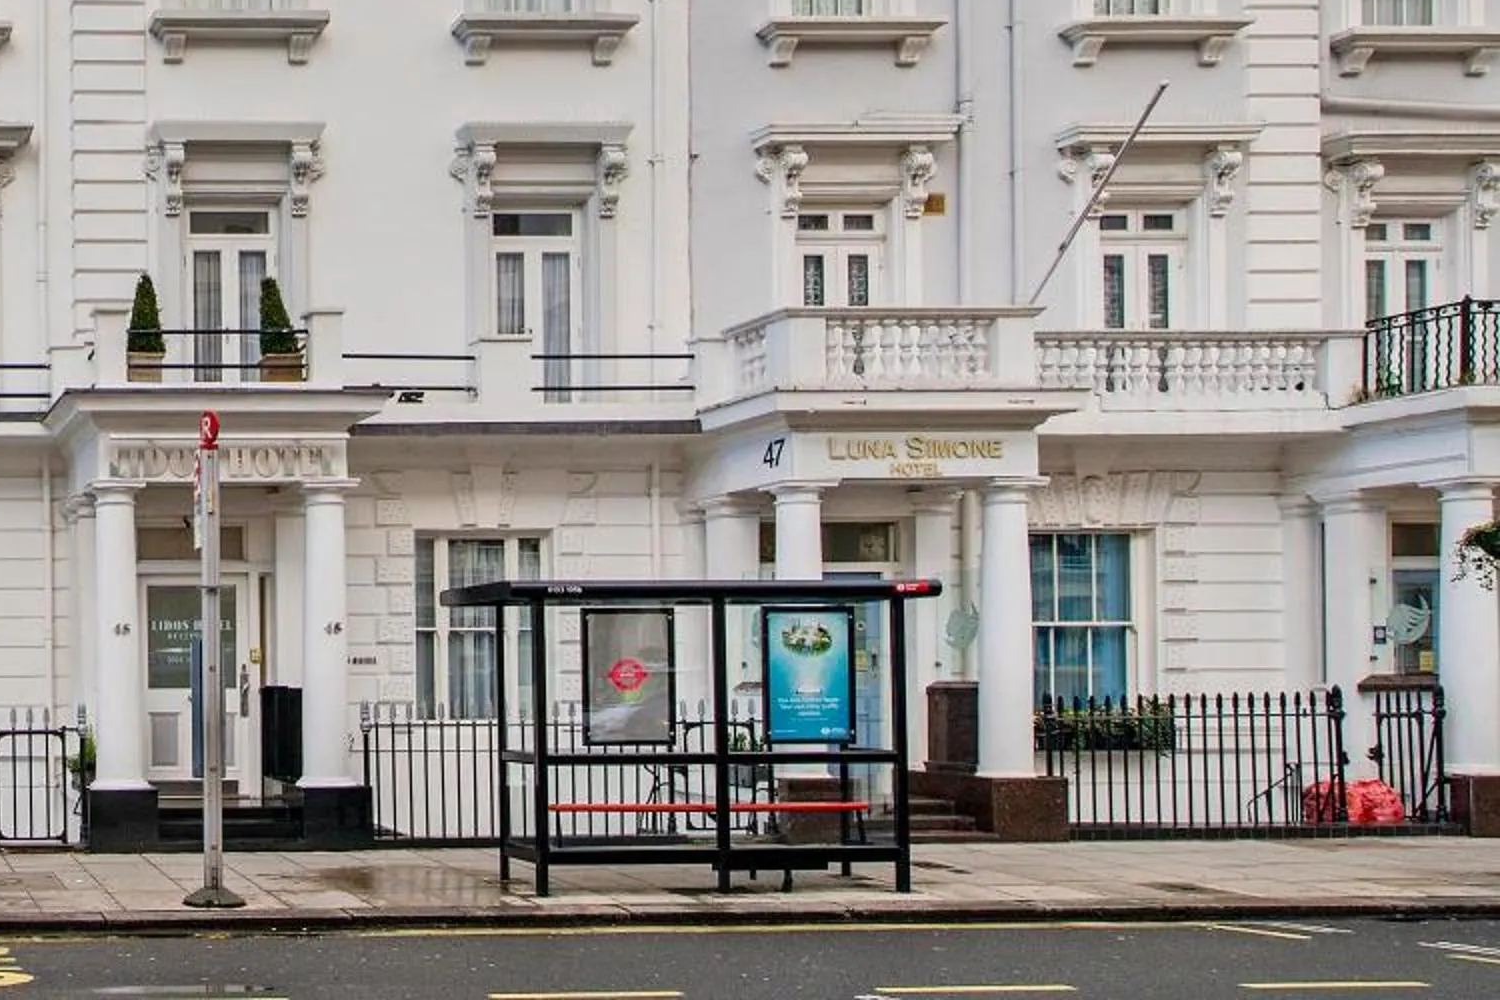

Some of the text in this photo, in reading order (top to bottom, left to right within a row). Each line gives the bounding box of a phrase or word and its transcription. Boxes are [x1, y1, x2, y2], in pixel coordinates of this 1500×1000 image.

[762, 438, 786, 469] 47
[827, 434, 1004, 461] LUNA SIMONE
[108, 446, 196, 479] LIDO
[889, 462, 943, 478] HOTEL
